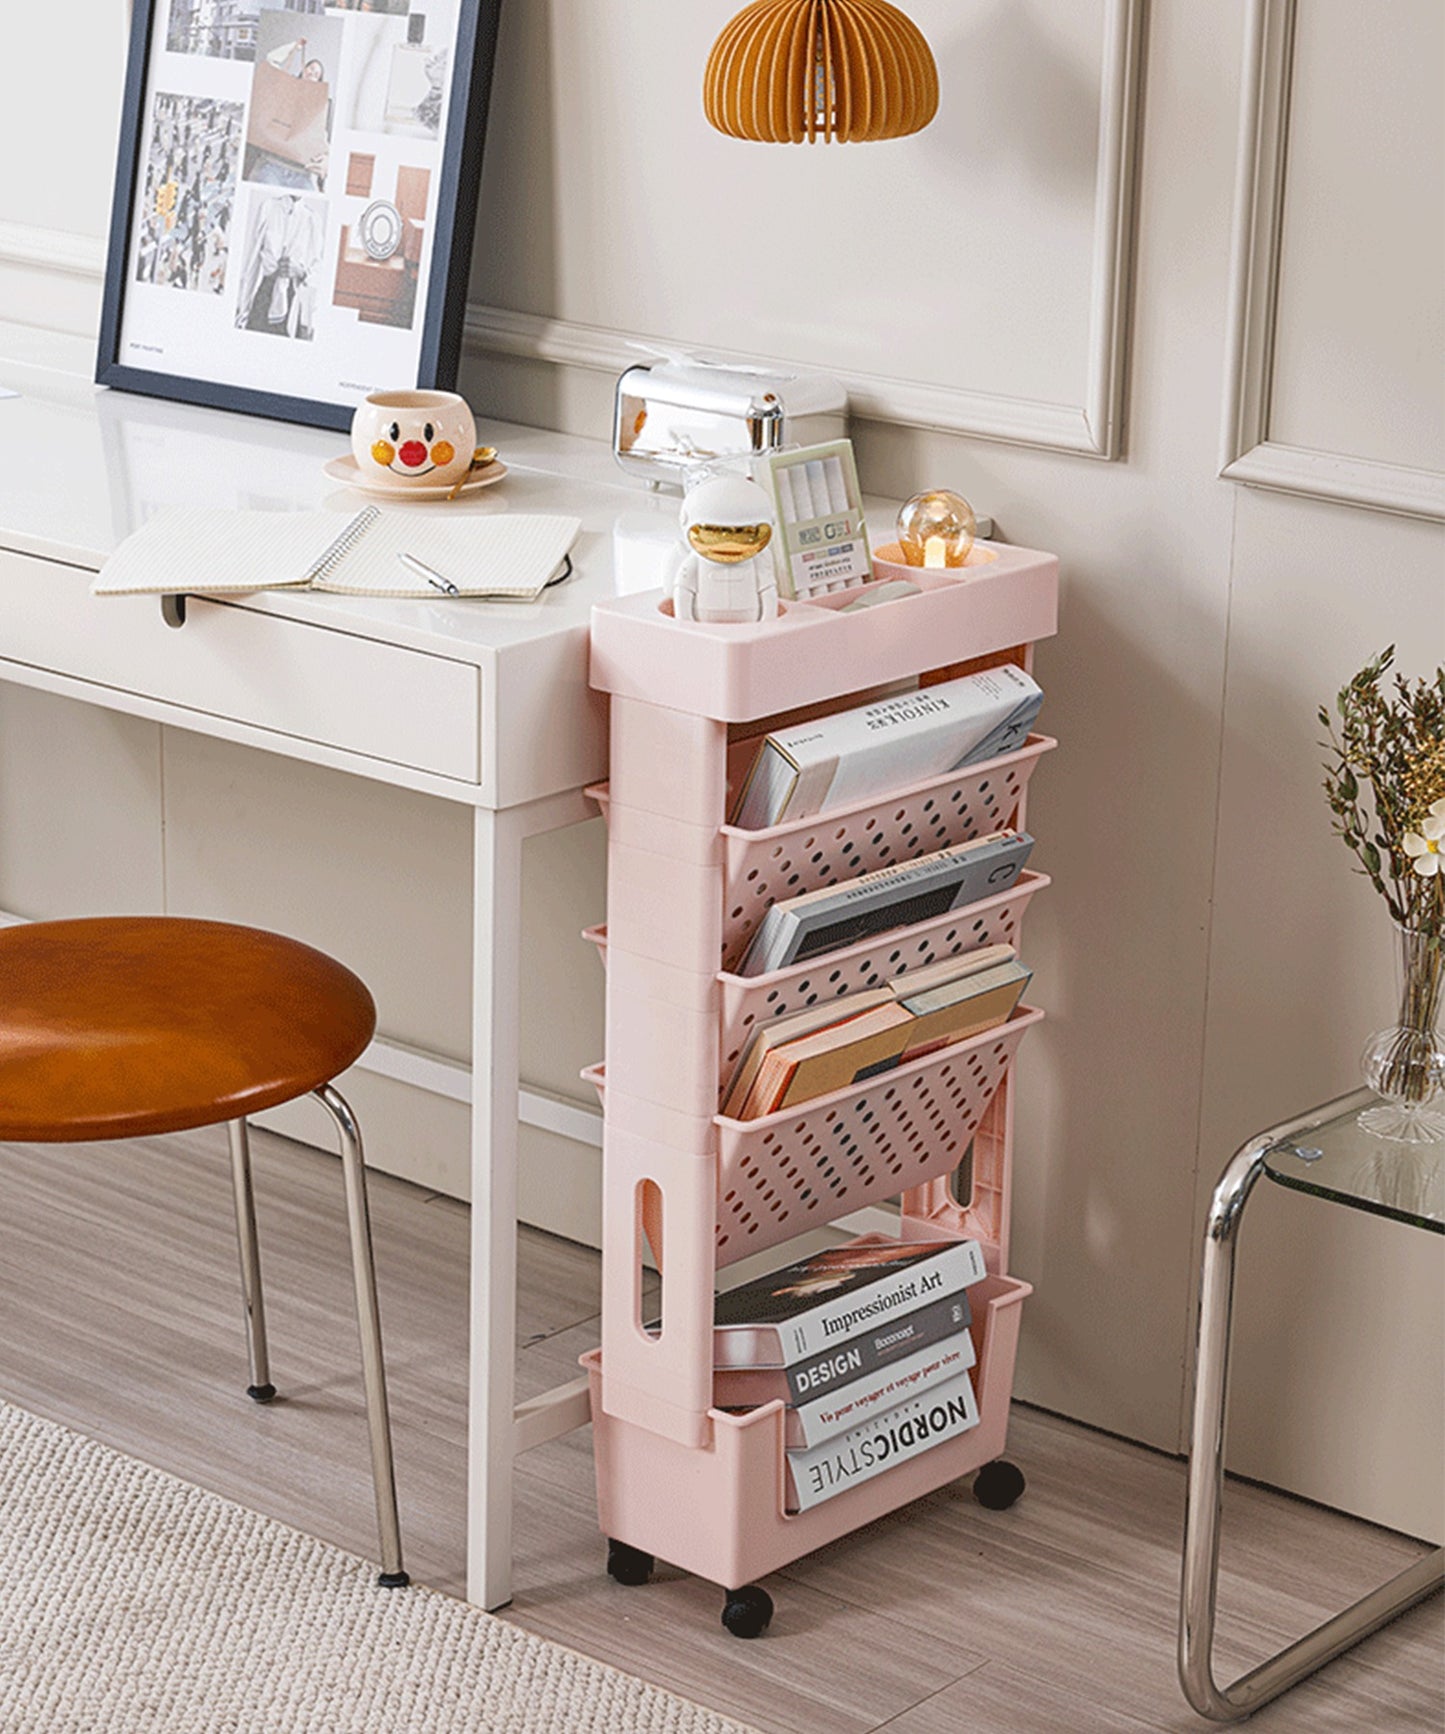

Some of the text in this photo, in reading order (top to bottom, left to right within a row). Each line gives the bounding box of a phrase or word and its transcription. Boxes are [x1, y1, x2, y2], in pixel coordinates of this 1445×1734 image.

[884, 698, 950, 725] KINFOLK
[820, 1281, 918, 1338] Impressionist
[919, 1270, 944, 1295] Art
[794, 1347, 863, 1394] DESIGN
[808, 1395, 969, 1494] NORDICSTYLE
